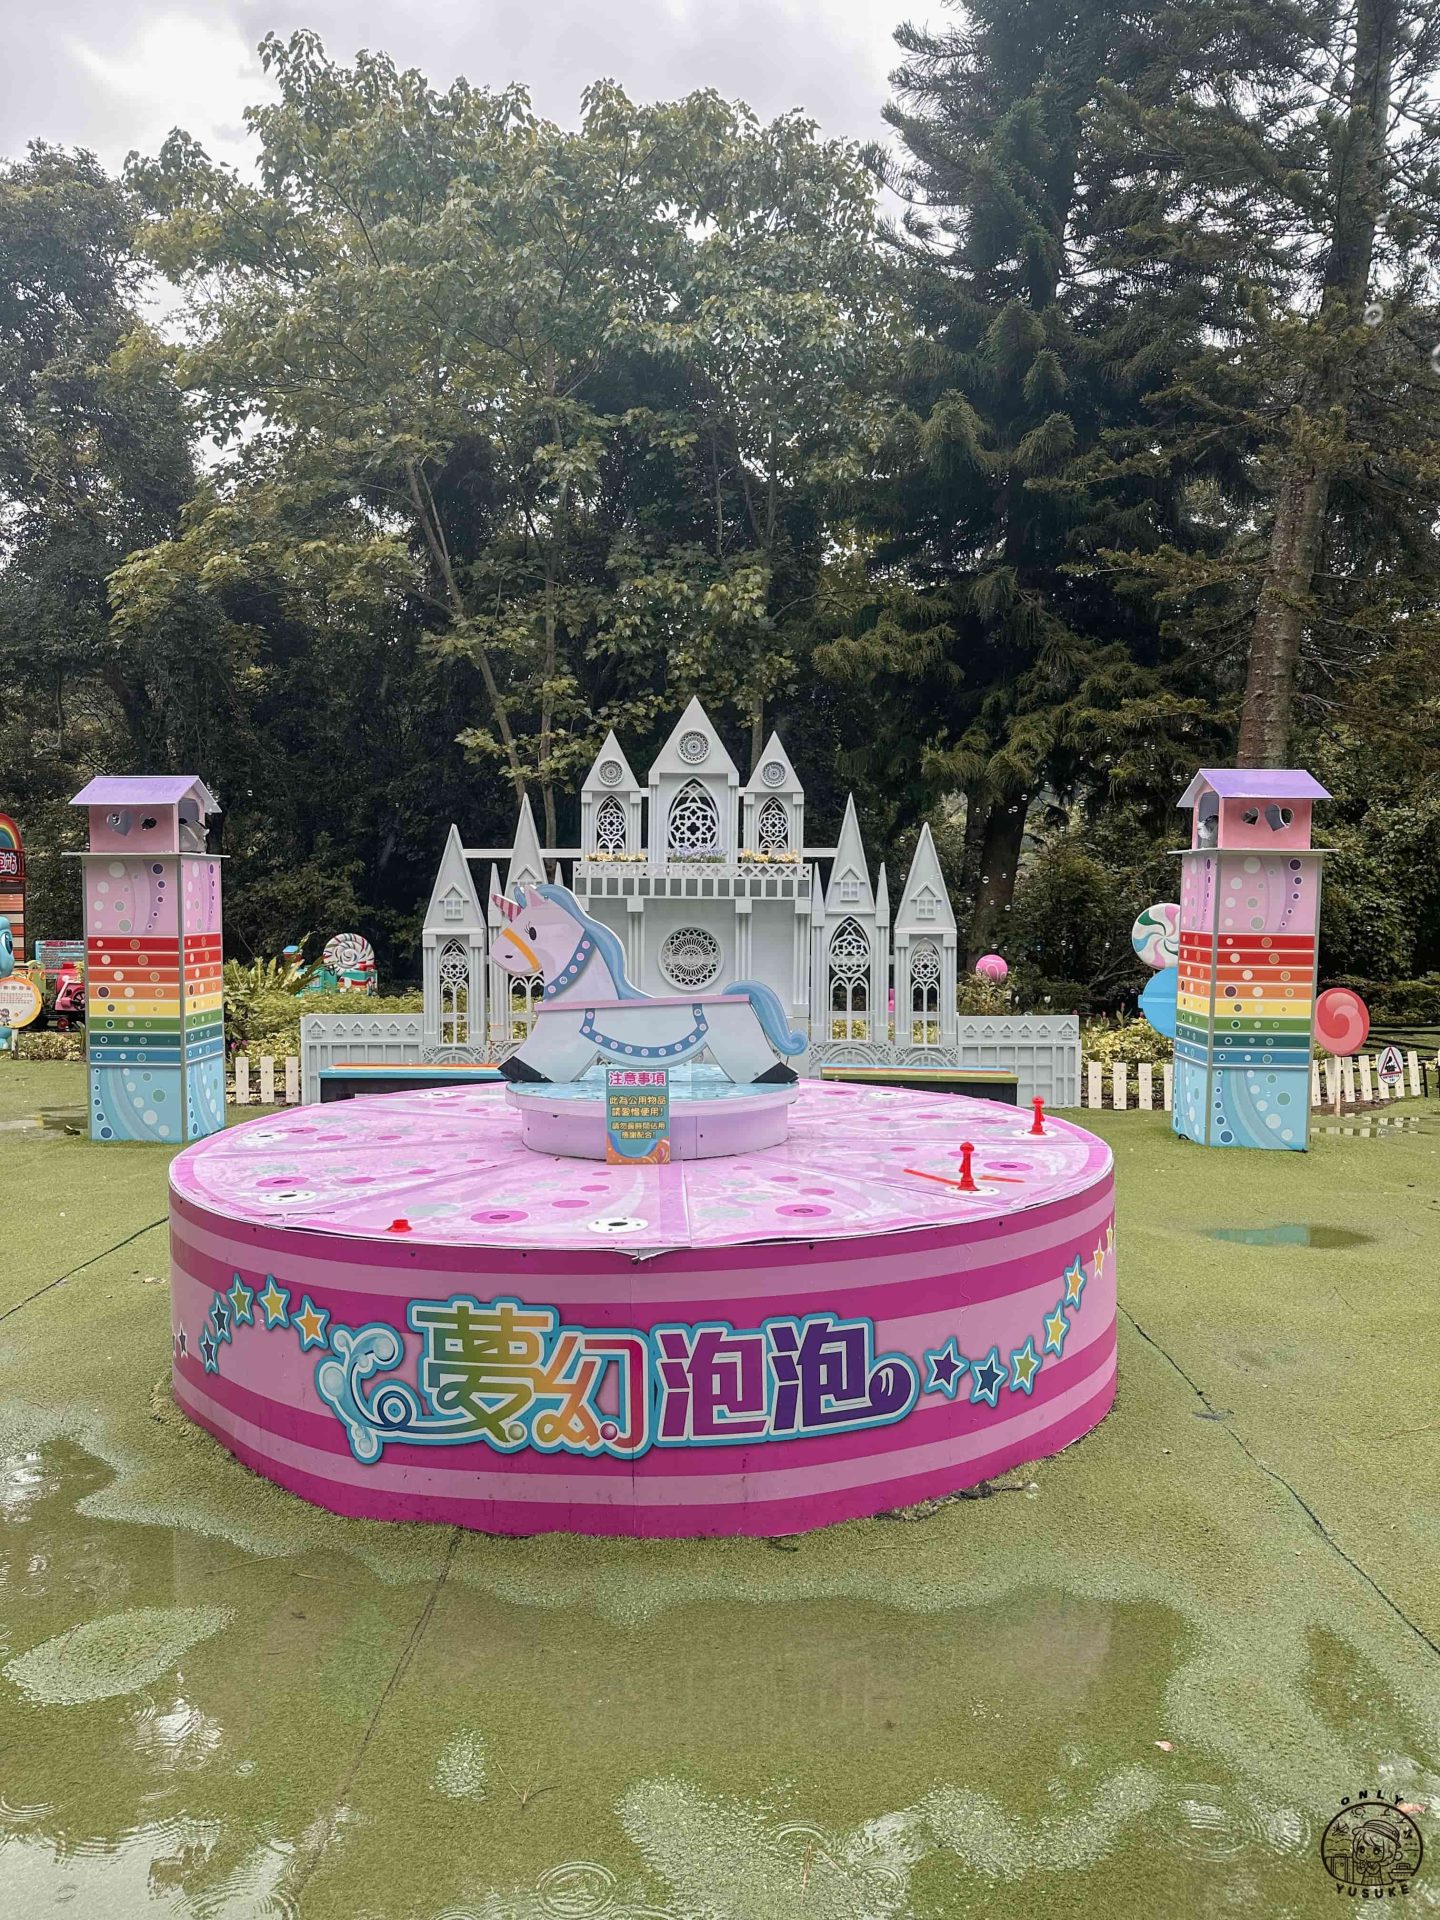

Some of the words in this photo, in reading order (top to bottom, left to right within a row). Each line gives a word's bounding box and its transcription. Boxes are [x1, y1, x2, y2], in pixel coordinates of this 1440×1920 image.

[608, 1070, 667, 1087] 注意事項
[609, 1096, 667, 1105] 此為公用物品
[411, 1300, 915, 1453] 夢幻泡泡
